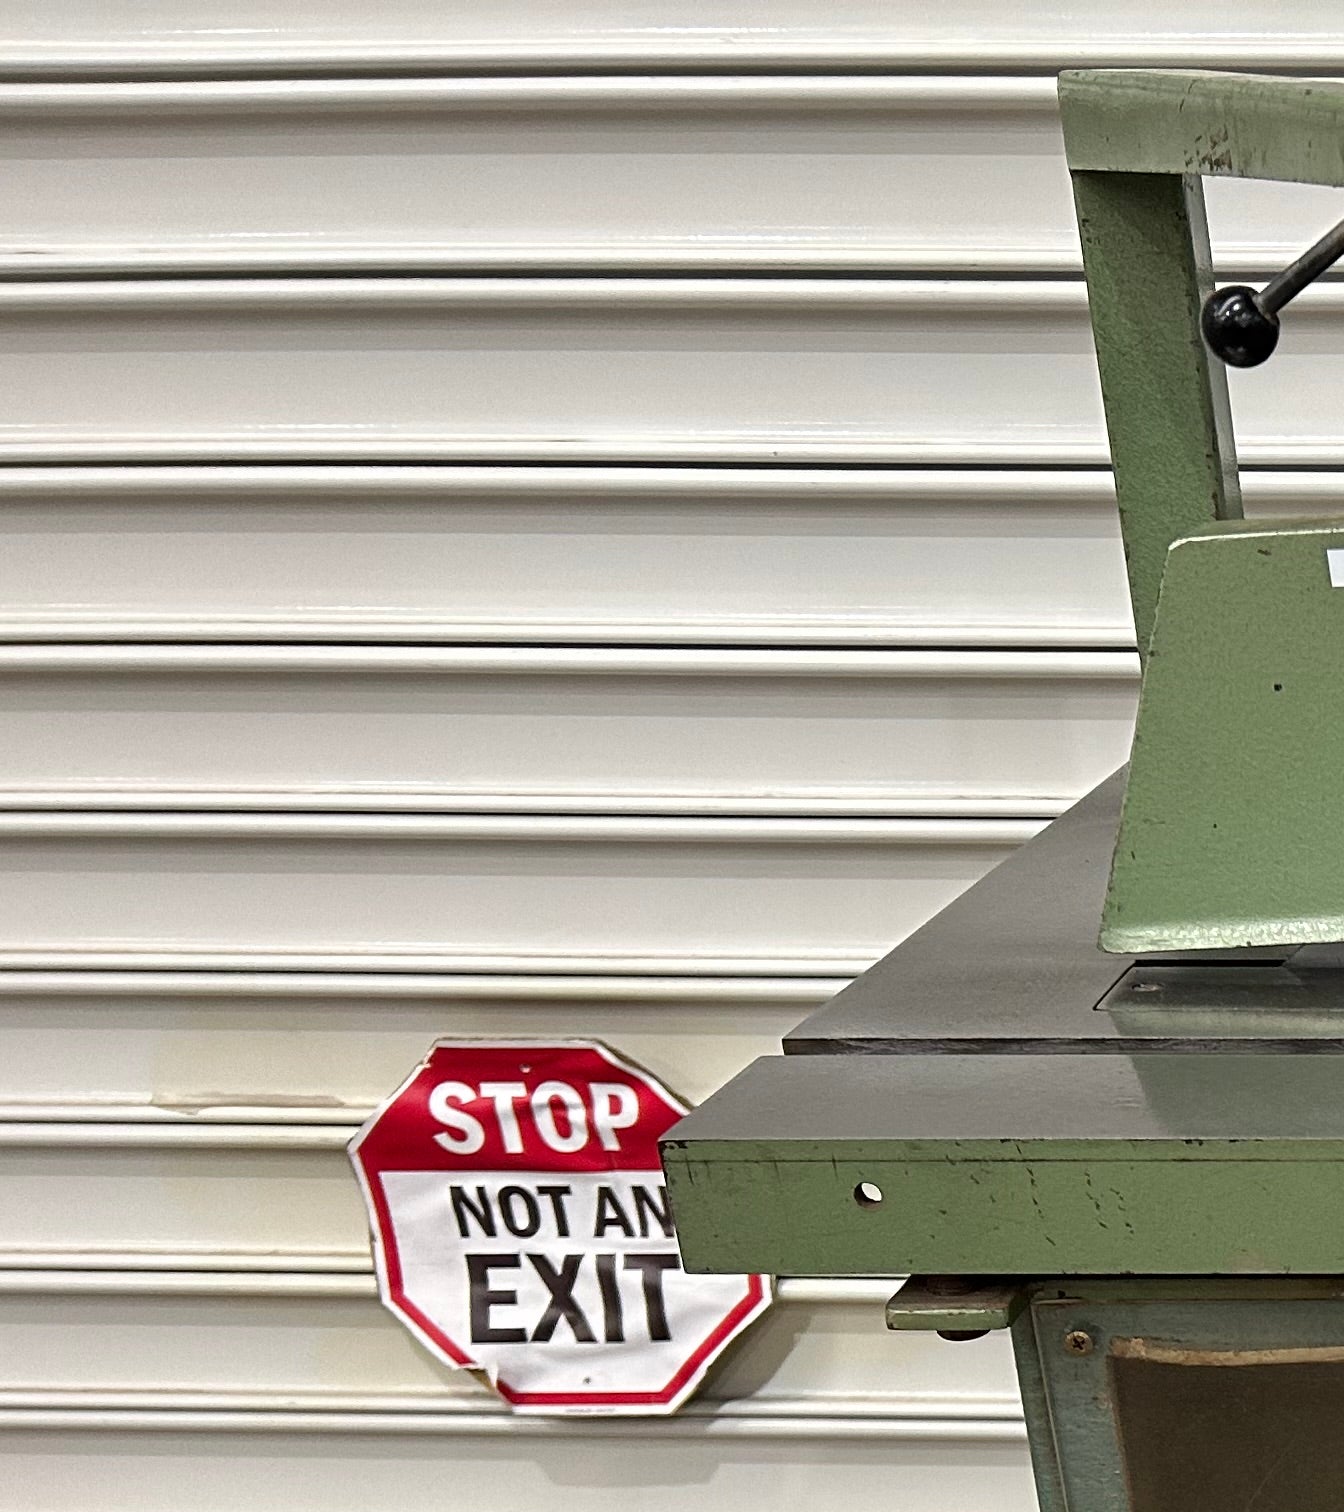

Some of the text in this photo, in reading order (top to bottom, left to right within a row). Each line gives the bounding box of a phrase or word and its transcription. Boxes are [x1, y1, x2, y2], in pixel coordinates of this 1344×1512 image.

[428, 1079, 640, 1156] STOP
[449, 1185, 675, 1239] NOT AN
[465, 1253, 681, 1344] EXIT
